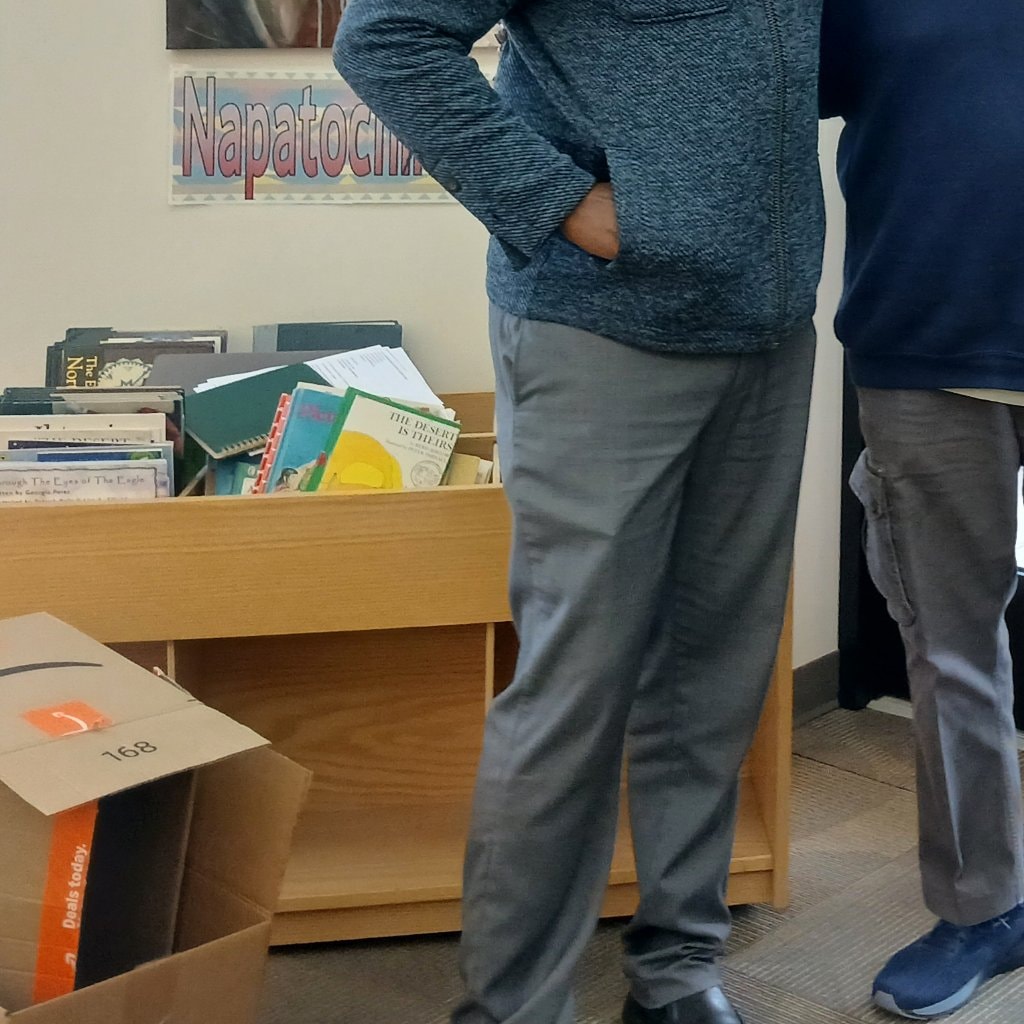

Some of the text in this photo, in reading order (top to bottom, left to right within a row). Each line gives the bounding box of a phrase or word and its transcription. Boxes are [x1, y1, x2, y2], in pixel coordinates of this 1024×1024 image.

[85, 356, 98, 378] The
[390, 412, 455, 441] THE DESERT
[398, 426, 409, 436] IS
[412, 431, 453, 451] THEIRS
[31, 476, 50, 486] The
[53, 476, 78, 488] Eyes
[81, 476, 91, 484] of
[94, 475, 113, 485] The
[117, 474, 145, 486] Eagle
[101, 741, 157, 761] 168
[62, 842, 88, 930] Deals today.
